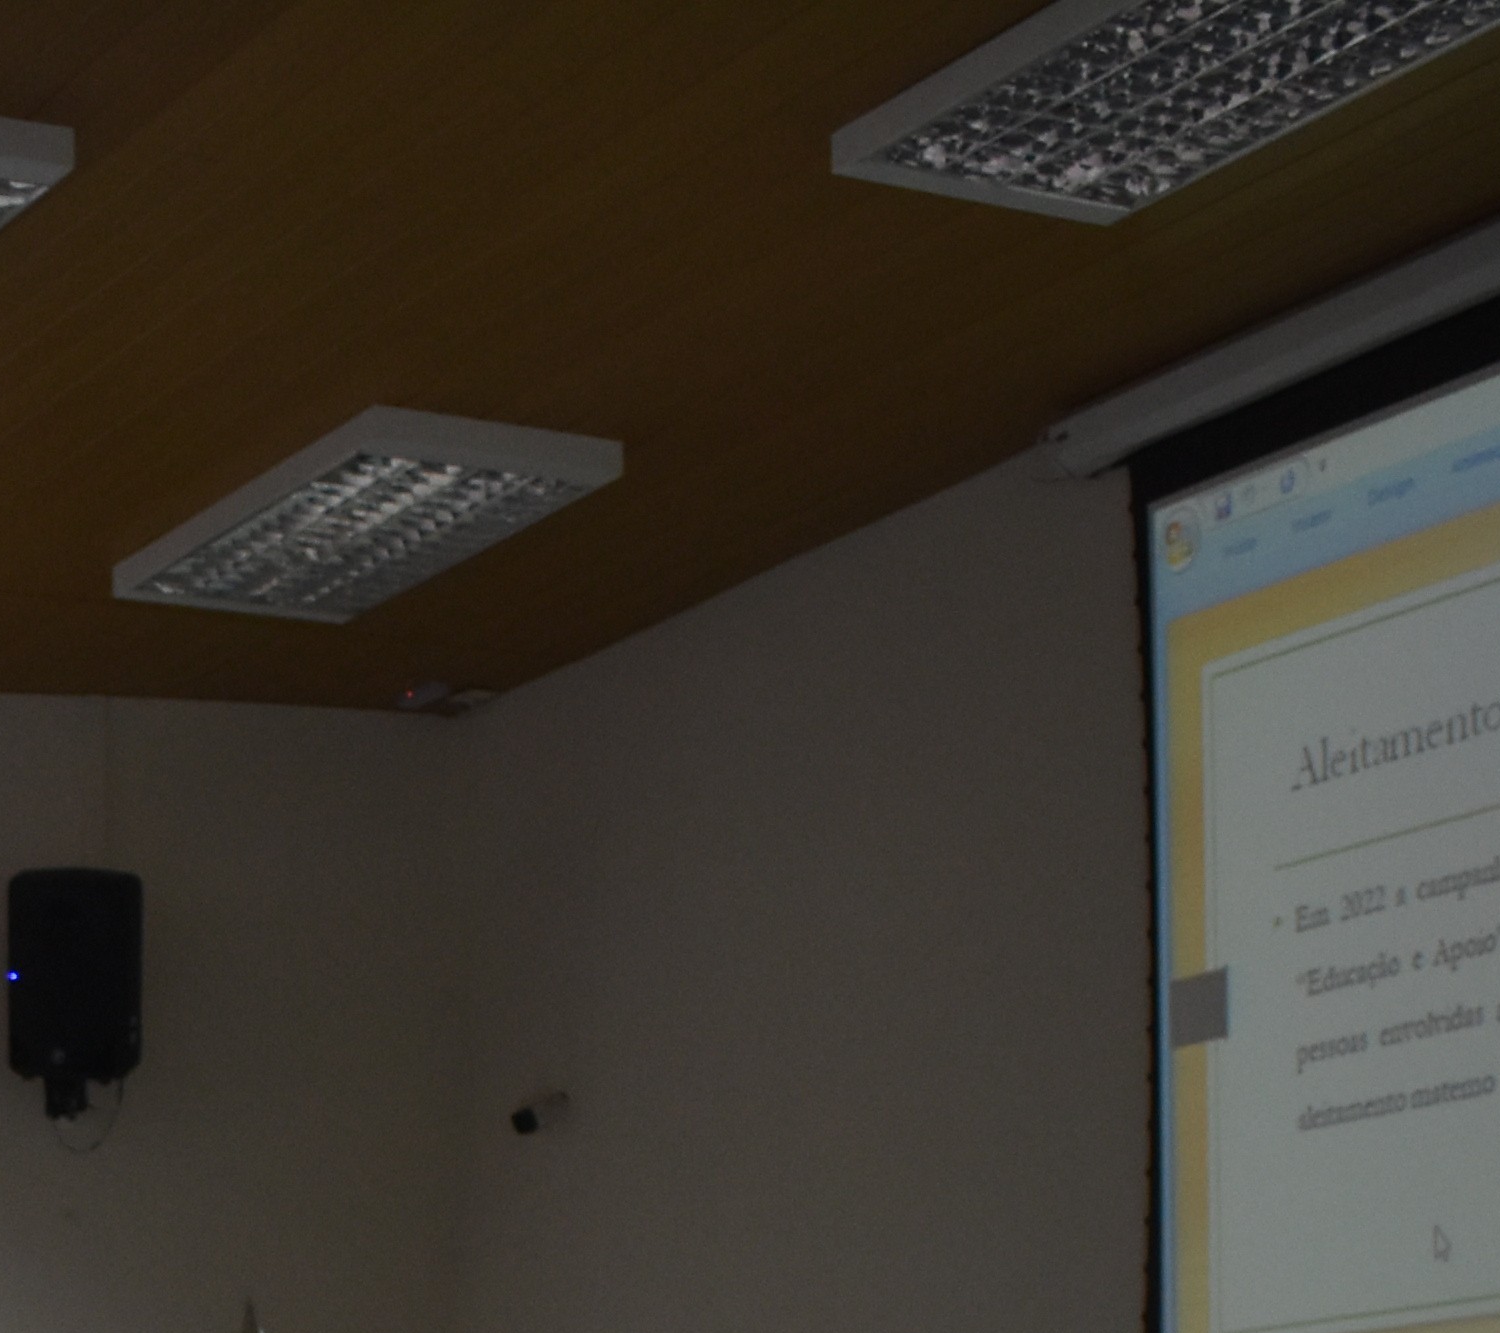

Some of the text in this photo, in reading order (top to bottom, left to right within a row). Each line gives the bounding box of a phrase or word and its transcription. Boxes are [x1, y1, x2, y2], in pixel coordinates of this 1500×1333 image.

[1295, 904, 1330, 933] Em
[1341, 885, 1386, 922] 2022
[1412, 951, 1424, 969] e
[1296, 1031, 1368, 1074] pessoas
[1379, 1001, 1484, 1048] envolvidas
[1297, 1090, 1407, 1131] aleitamento
[1411, 1072, 1496, 1110] materno
